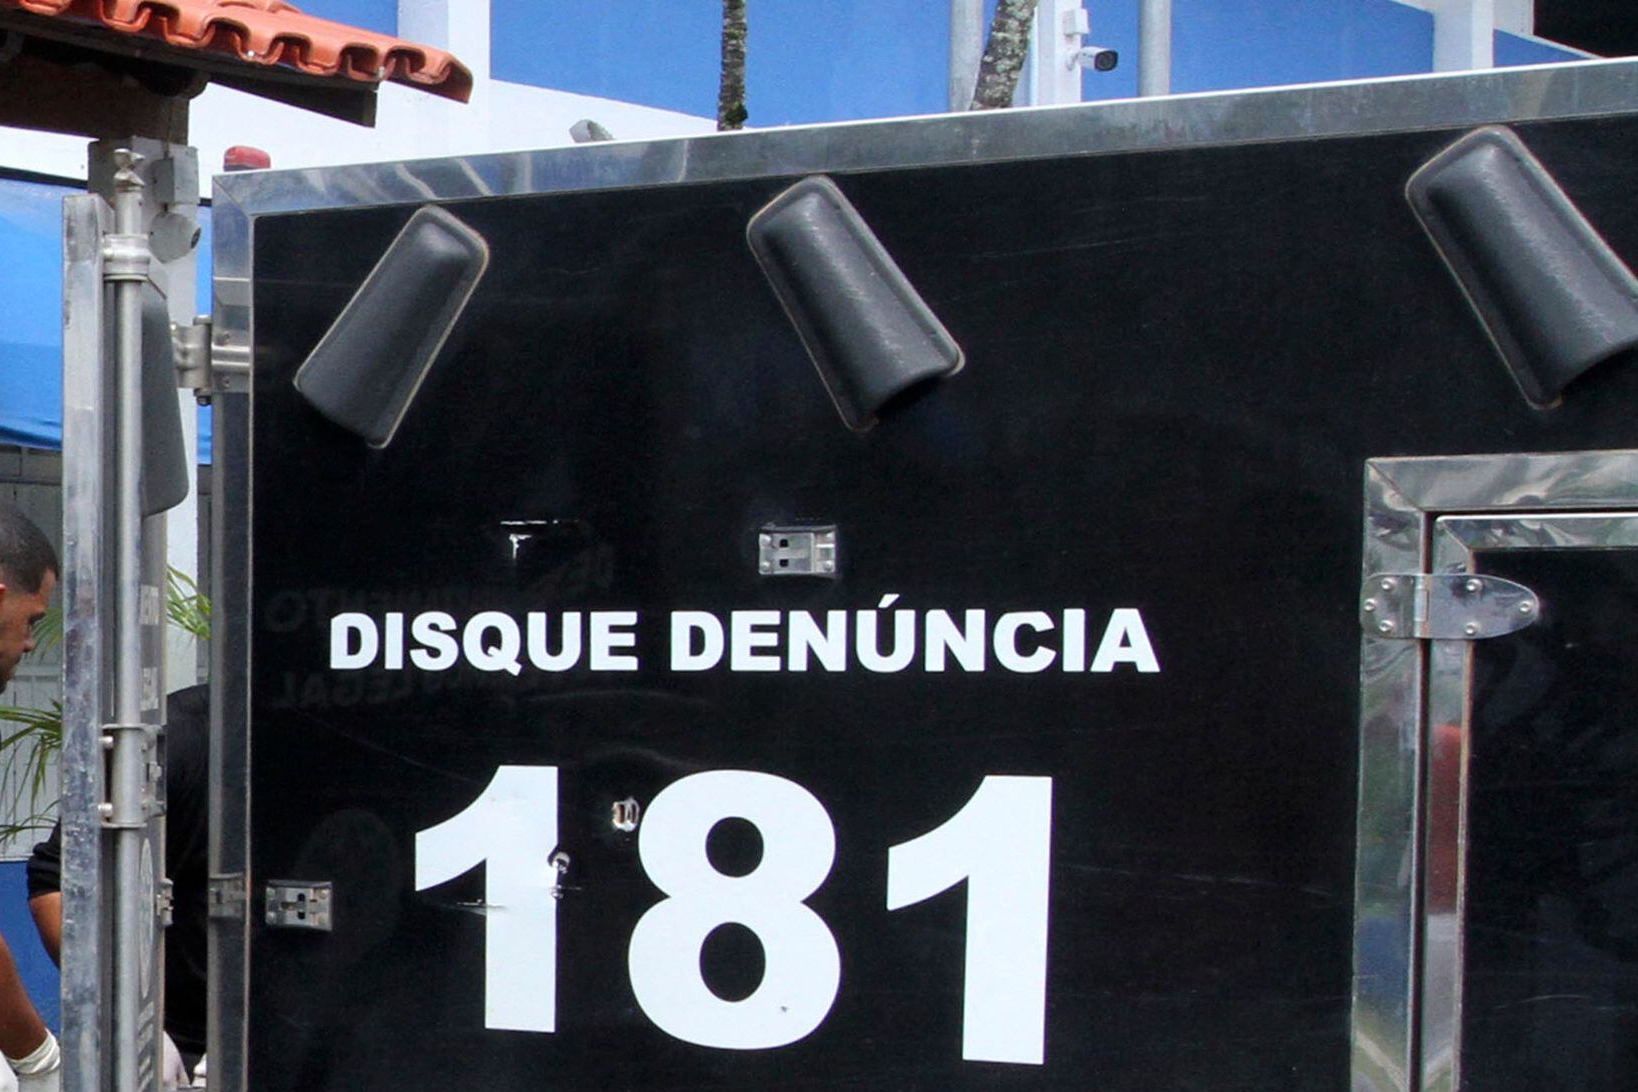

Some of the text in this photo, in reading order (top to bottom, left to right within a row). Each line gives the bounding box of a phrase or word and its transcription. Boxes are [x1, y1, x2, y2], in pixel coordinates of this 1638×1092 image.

[331, 594, 1160, 676] DISQUE DENÚNCIA
[415, 764, 1053, 1065] 181
